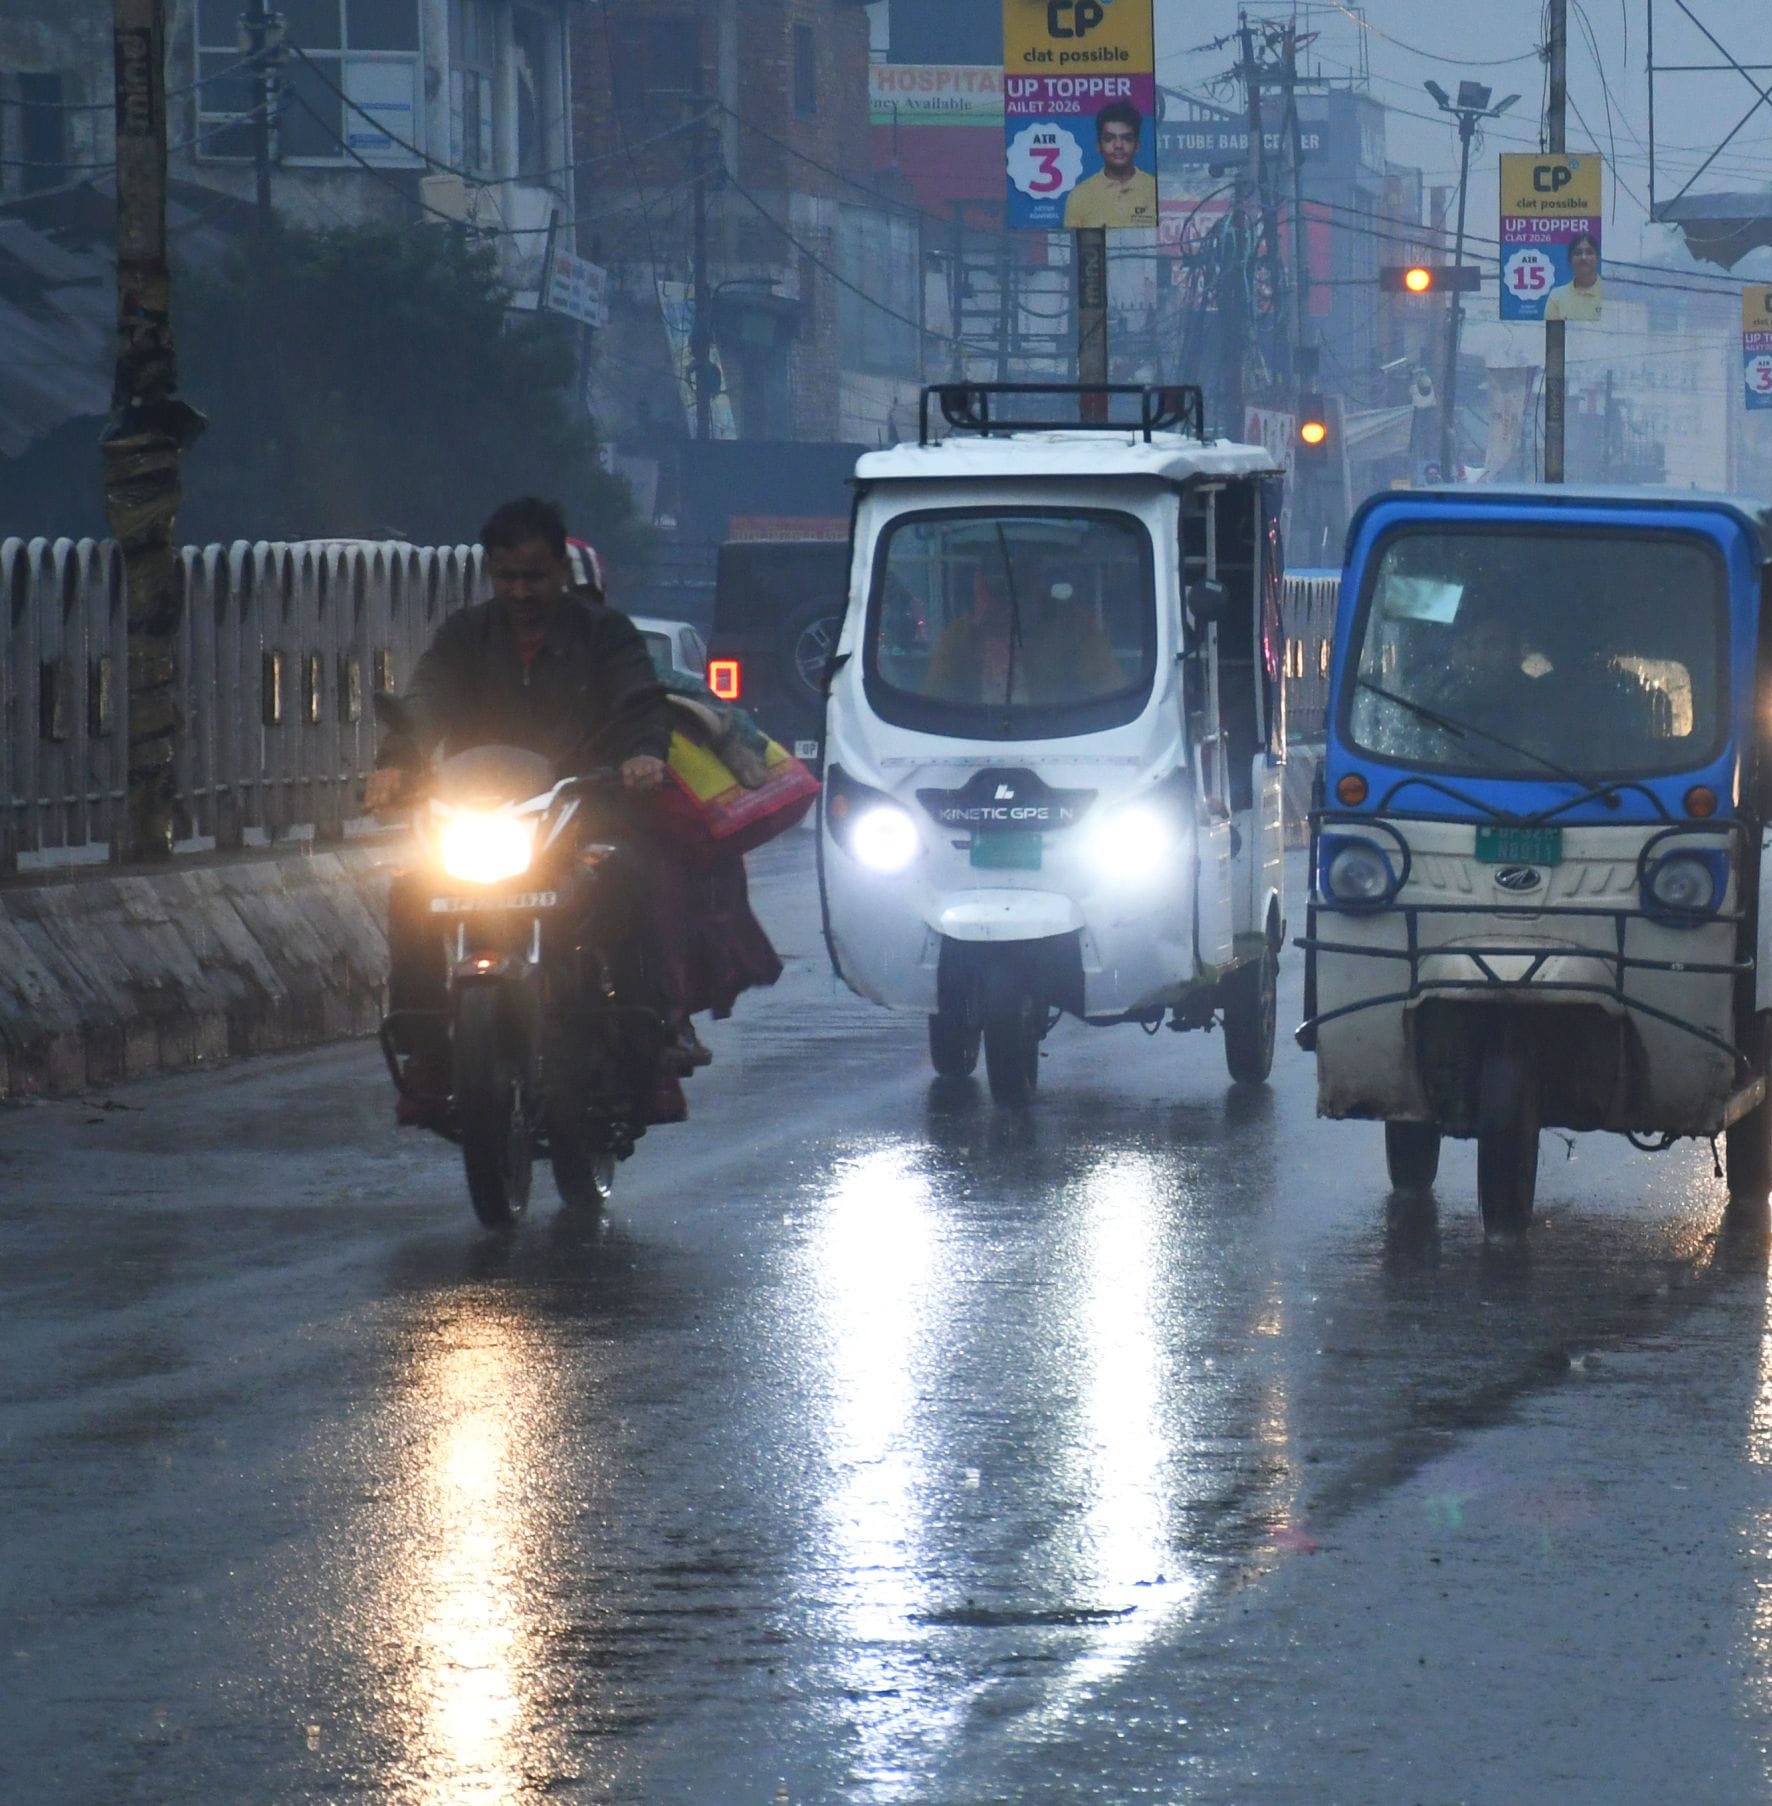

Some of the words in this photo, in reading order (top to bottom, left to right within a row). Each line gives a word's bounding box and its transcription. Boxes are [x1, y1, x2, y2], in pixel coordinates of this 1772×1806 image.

[1048, 0, 1104, 38] CP
[1024, 47, 1053, 62] clat
[1060, 46, 1129, 65] possible
[879, 69, 1004, 92] HOSPITA
[1008, 79, 1038, 97] UP
[1045, 79, 1132, 97] TOPPER
[907, 97, 972, 110] Available
[1008, 101, 1043, 113] AILET
[1048, 101, 1081, 113] 2026
[1033, 134, 1057, 145] AIR
[1177, 134, 1214, 149] TUBE
[1219, 134, 1249, 149] BAB
[1263, 134, 1320, 149] CEER
[1029, 148, 1063, 192] 3
[1533, 166, 1572, 192] CP
[1517, 198, 1537, 208] clat
[1541, 197, 1588, 210] possible
[1505, 219, 1526, 231] UP
[1531, 219, 1589, 231] TOPPER
[1513, 266, 1546, 289] 15
[1745, 332, 1761, 343] UP
[941, 807, 1008, 820] KINETIC
